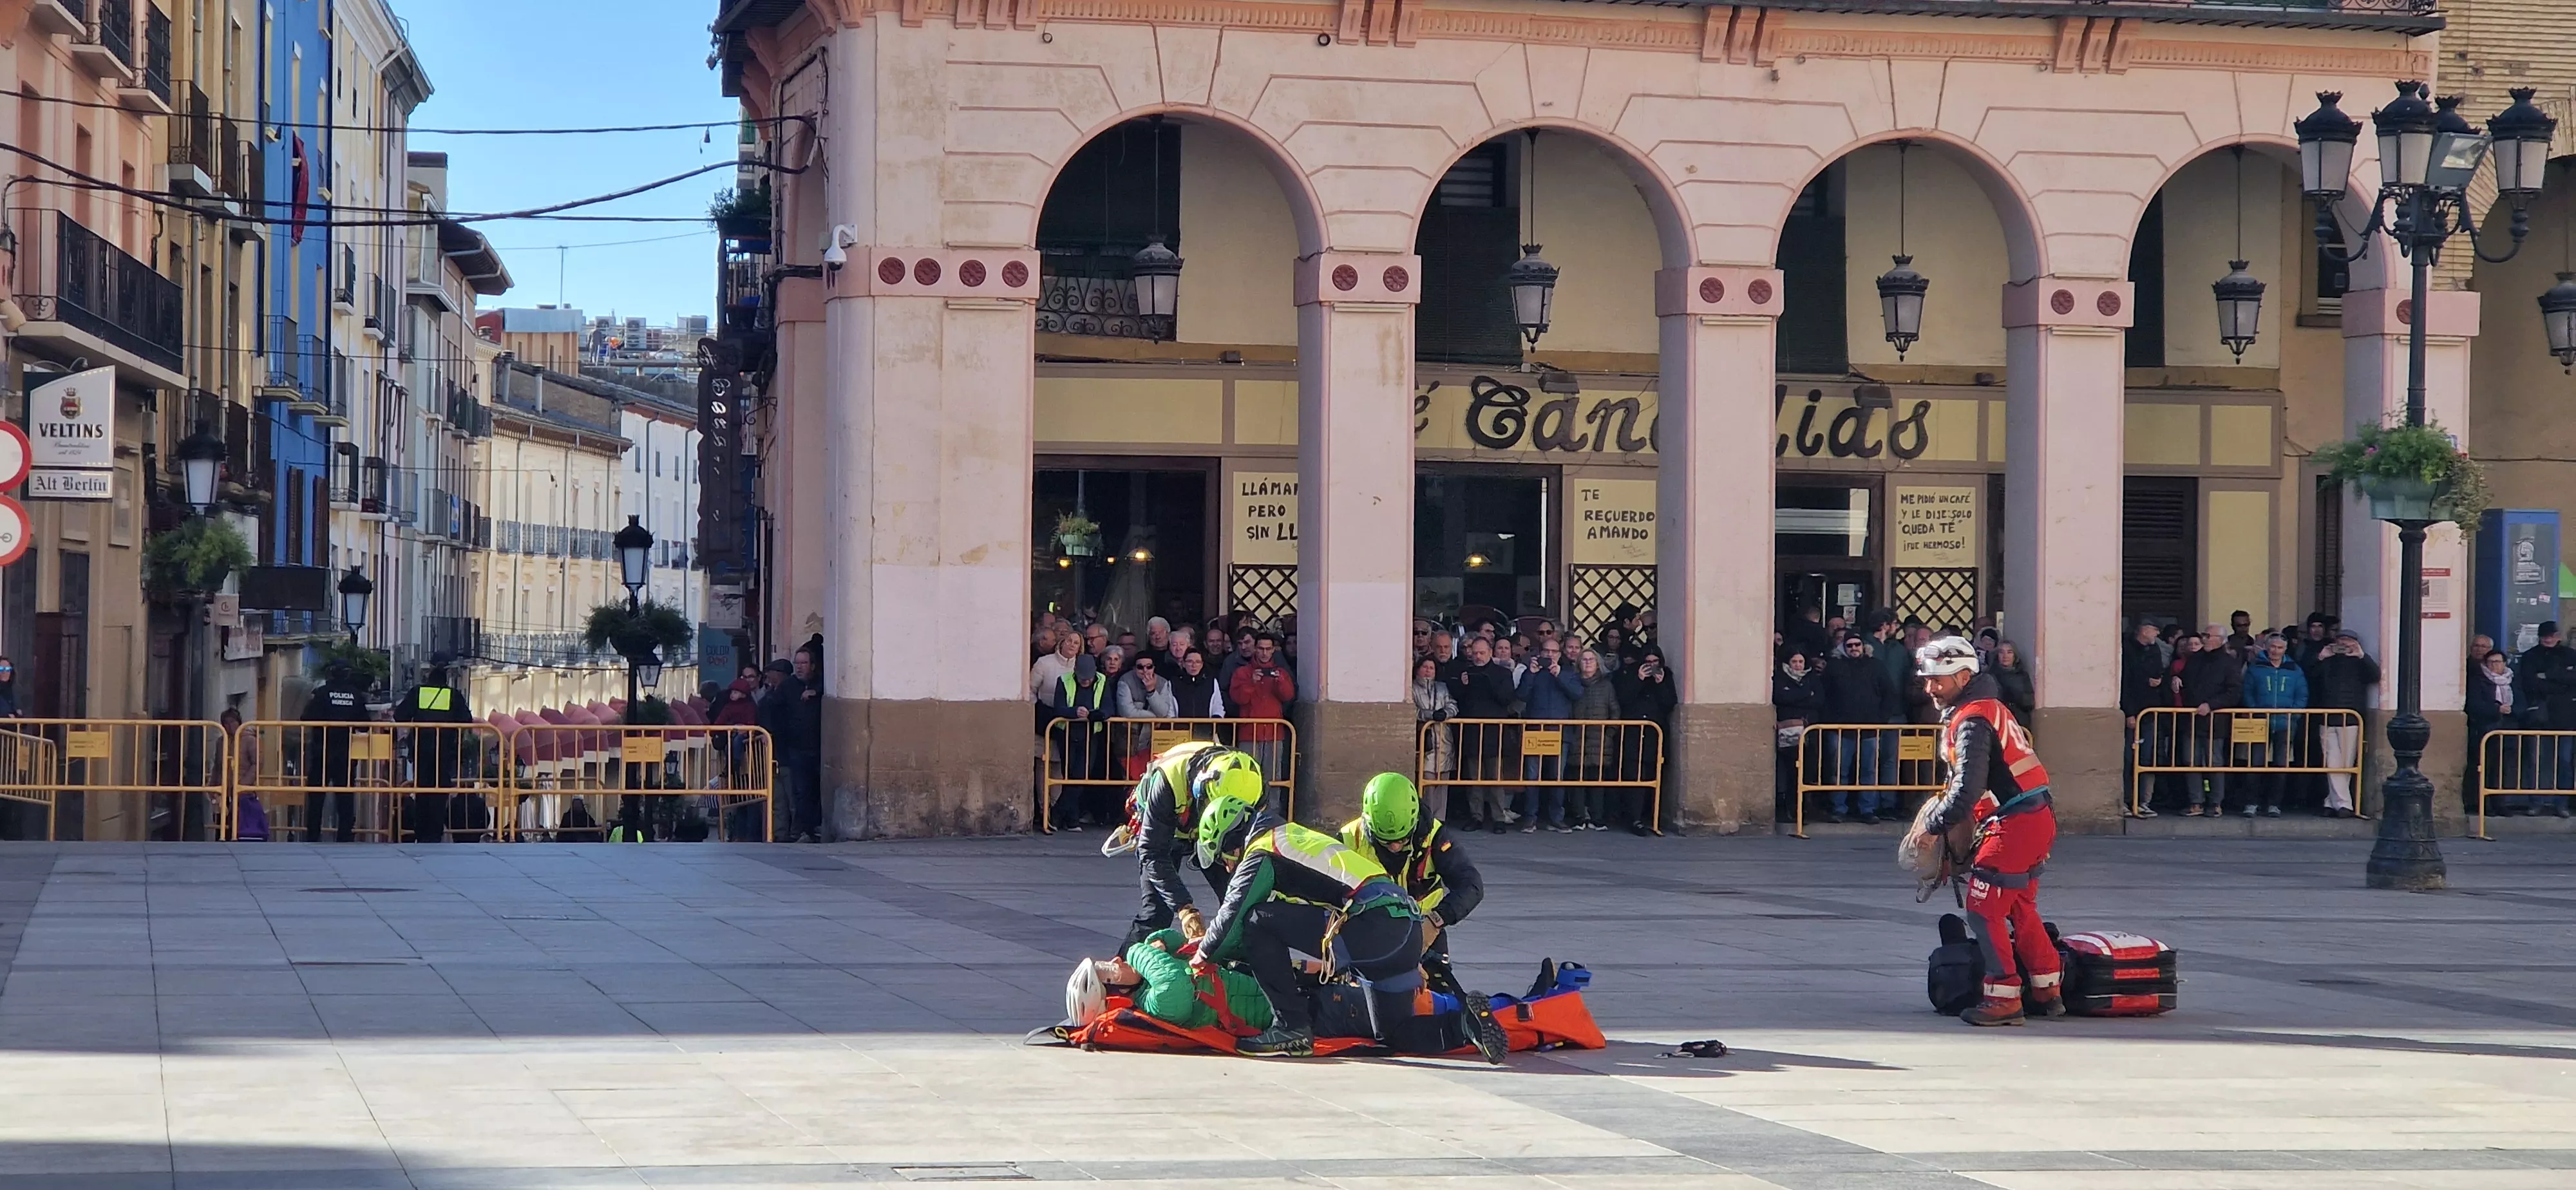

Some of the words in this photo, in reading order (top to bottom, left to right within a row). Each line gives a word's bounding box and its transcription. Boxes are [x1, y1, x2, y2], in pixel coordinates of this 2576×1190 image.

[39, 422, 103, 438] VELTINS
[34, 476, 57, 491] Alt
[62, 476, 106, 491] Berlin
[1581, 489, 1600, 502] TE
[1900, 494, 1915, 504] ME
[1917, 492, 1936, 504] PIDIÓ
[1949, 492, 1971, 504] CAFÉ
[1248, 504, 1286, 518] PERO
[1584, 510, 1655, 523] RECUERDO
[1901, 509, 1908, 519] Y
[1911, 509, 1920, 519] LE
[1951, 509, 1972, 519] SOLO
[1246, 524, 1269, 542] SIN
